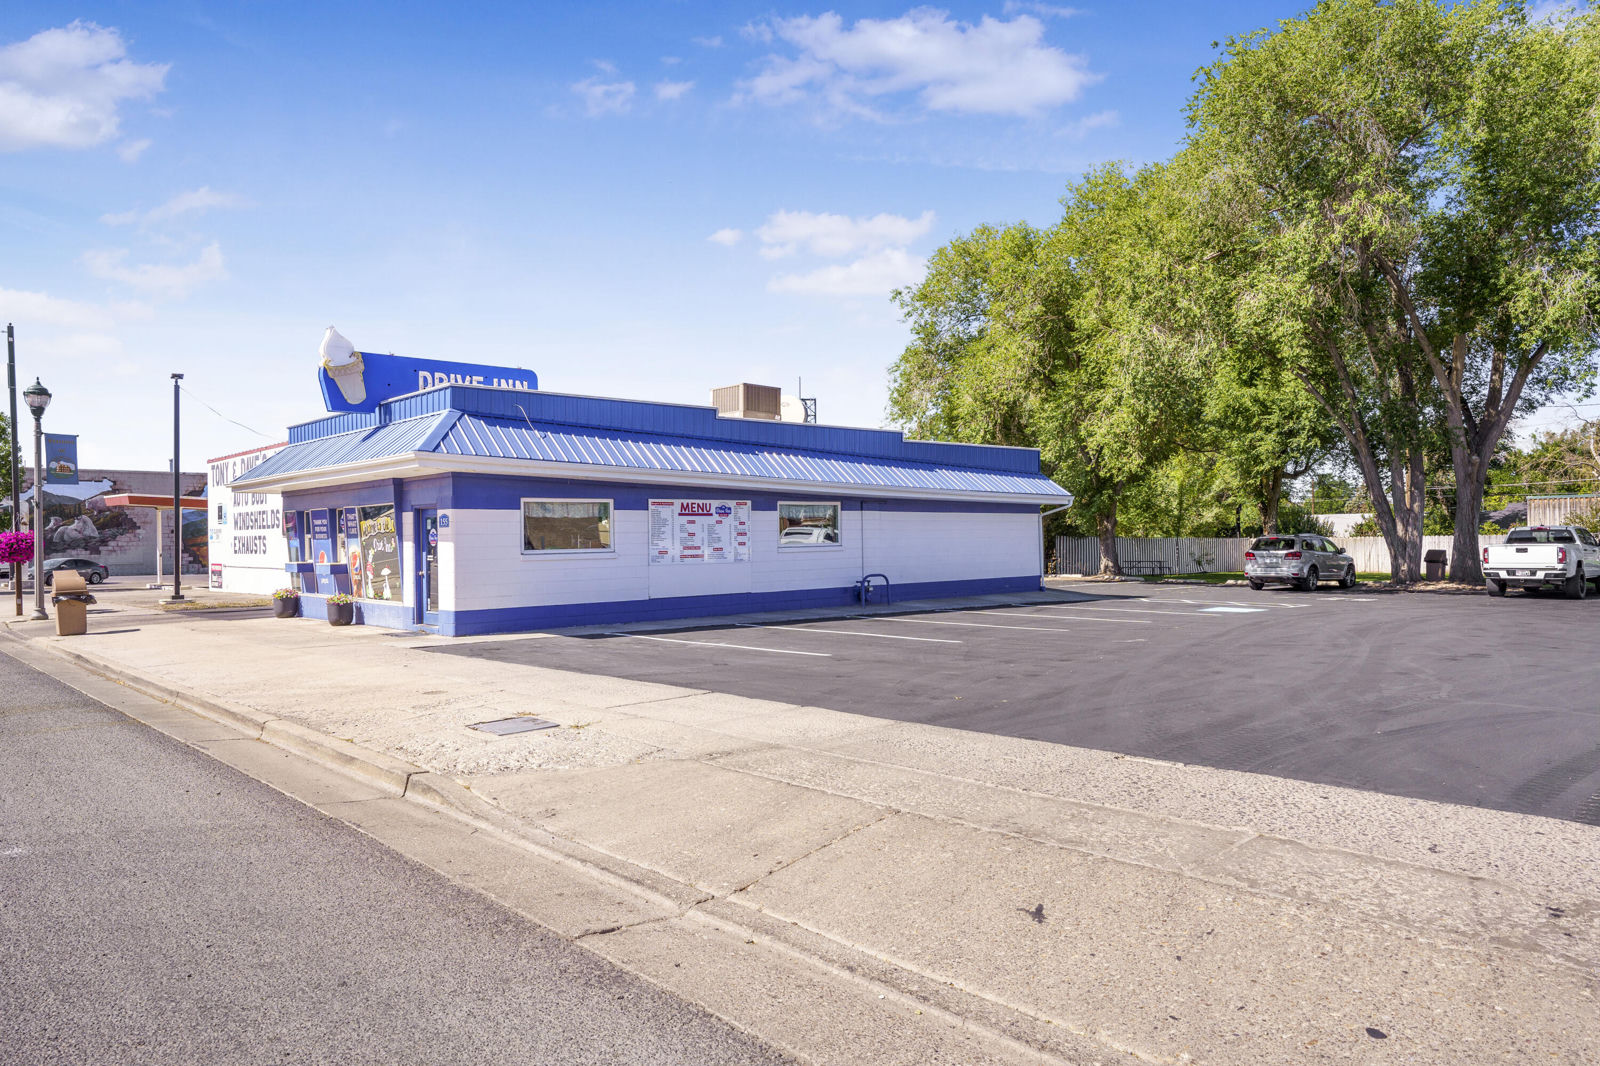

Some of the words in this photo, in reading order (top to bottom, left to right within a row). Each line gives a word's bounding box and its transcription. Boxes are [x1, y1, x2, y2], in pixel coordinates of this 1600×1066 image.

[211, 462, 229, 488] TONY
[680, 502, 712, 513] MENU
[233, 509, 281, 531] WINDSHIELDS
[440, 518, 448, 526] 155
[233, 535, 267, 555] EXHAUSTS
